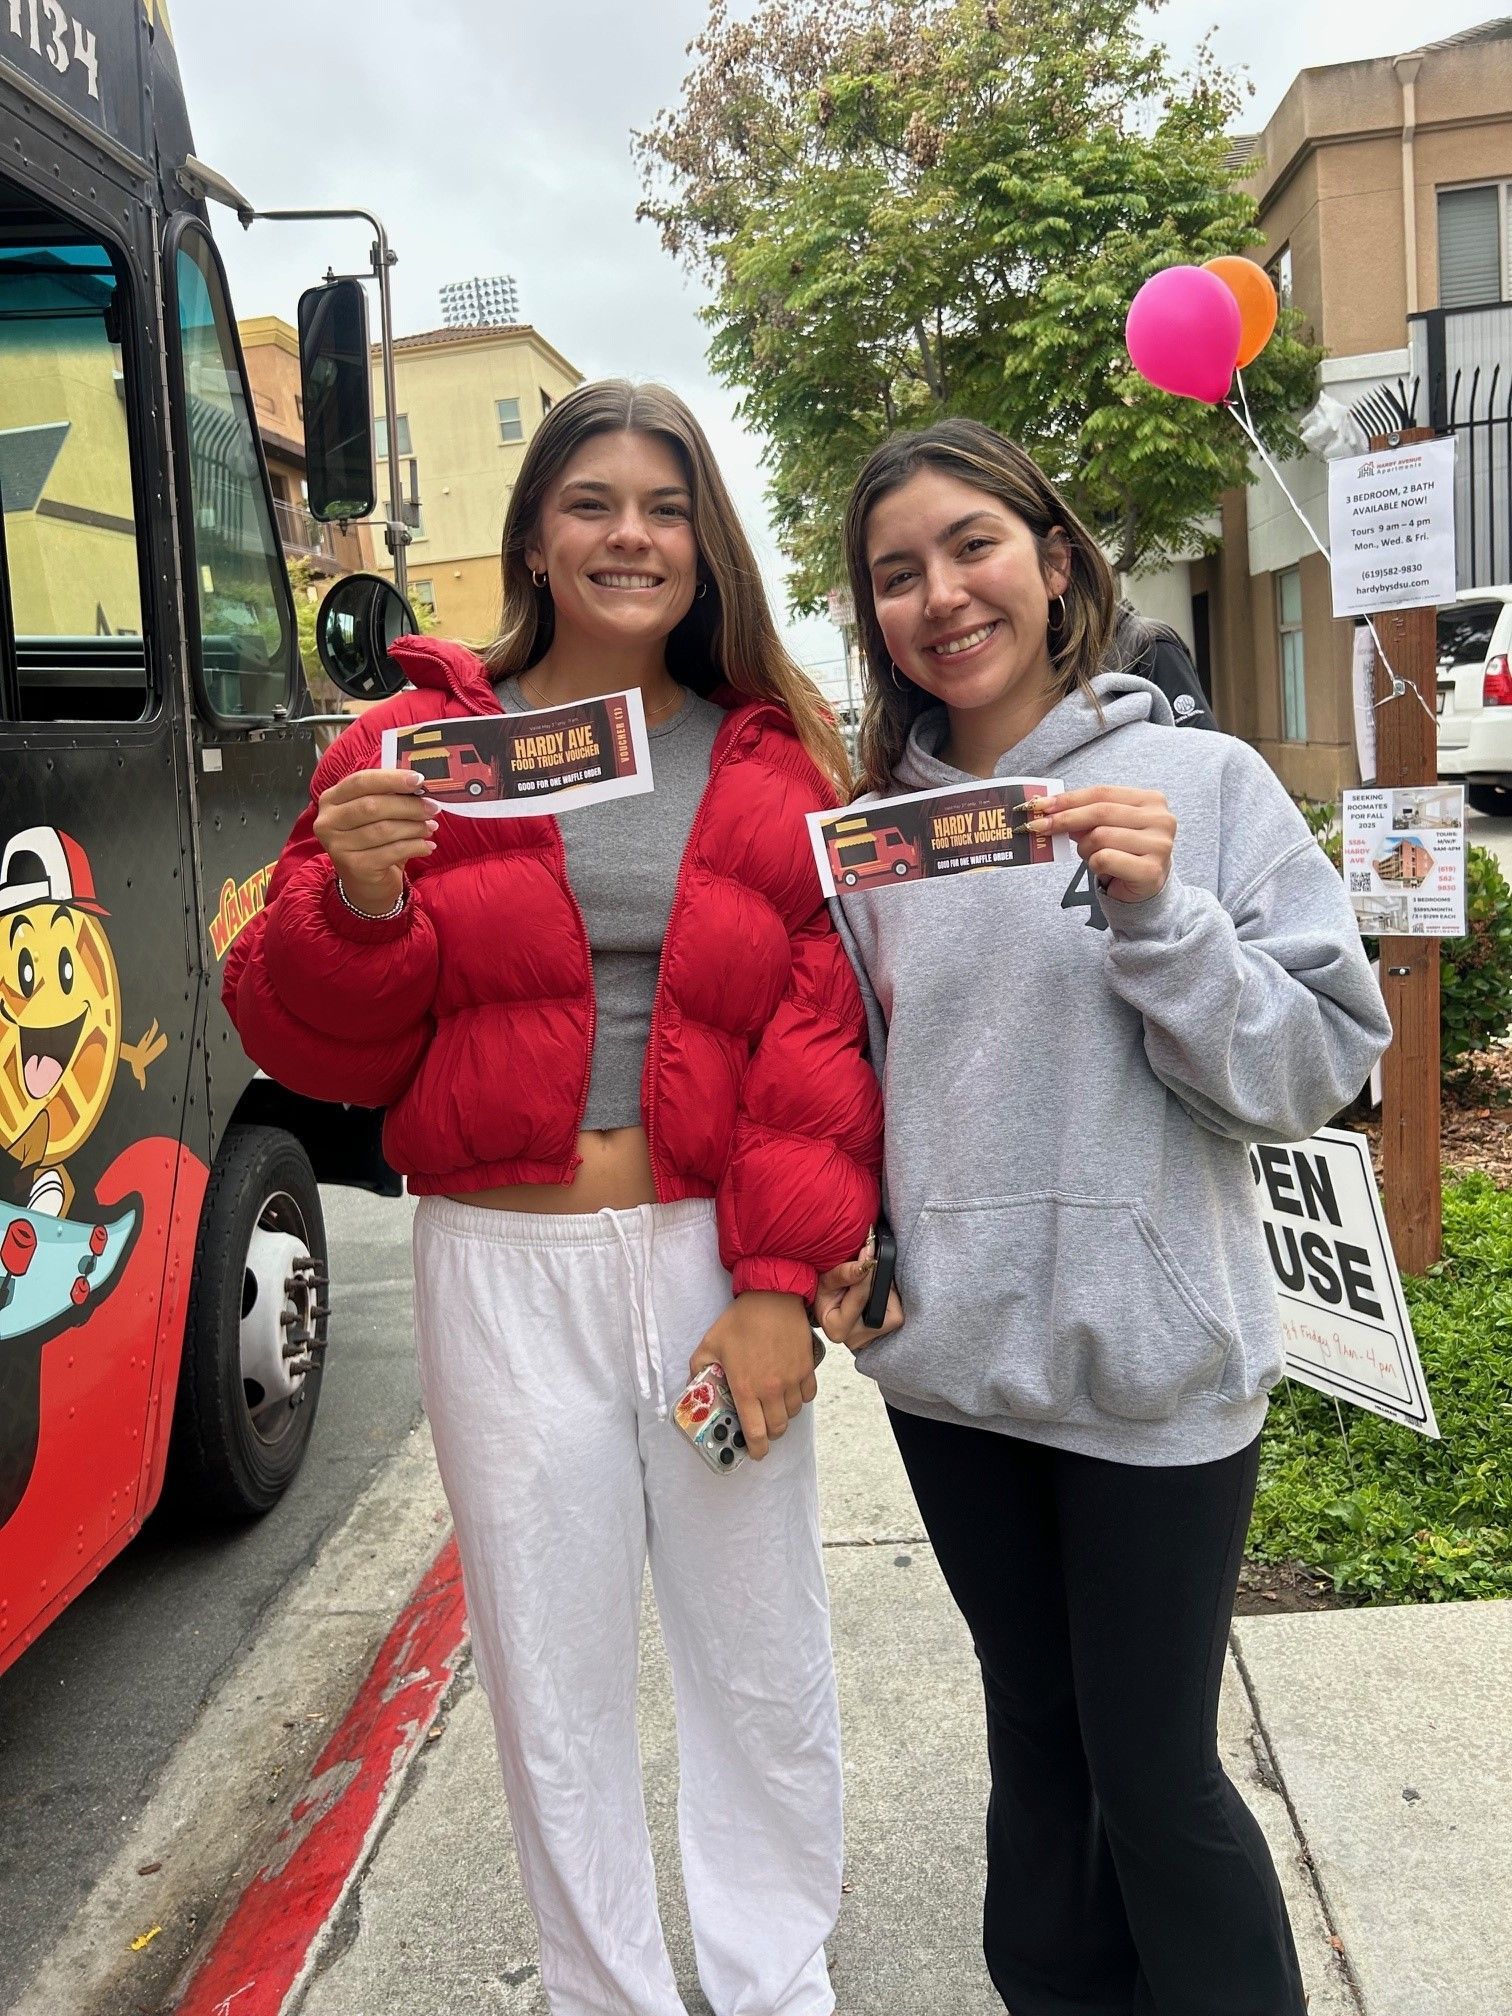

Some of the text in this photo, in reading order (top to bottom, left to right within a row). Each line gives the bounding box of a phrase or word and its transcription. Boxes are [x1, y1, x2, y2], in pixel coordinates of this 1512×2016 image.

[1346, 481, 1435, 504] 3 BEDROOM, 2 BATH
[1352, 496, 1427, 516] AVAILABLE NOW!
[1351, 527, 1375, 537] Tours
[1378, 524, 1384, 532] 9
[1386, 523, 1400, 531] am
[1408, 519, 1415, 527] 4
[1416, 518, 1431, 528] pm
[1354, 532, 1429, 551] Mon., Wed. & Fri.
[1361, 563, 1423, 581] (619)582-9830
[1356, 579, 1430, 595] hardybysdsu.com
[514, 725, 594, 759] HARDY AVE
[615, 722, 630, 763] VOUCHER
[511, 743, 600, 772] FOOD TRUCK VOUCHER
[517, 767, 602, 791] GOOD FOR ONE WAFFLE ORDER
[1347, 803, 1388, 811] ROOMATES
[933, 813, 974, 838] HARDY
[978, 808, 1007, 831] AVE
[931, 827, 1013, 851] FOOD TRUCK VOUCHER
[937, 851, 1014, 870] GOOD FOR ONE WAFFLE ORDER
[1250, 1144, 1343, 1228] EN
